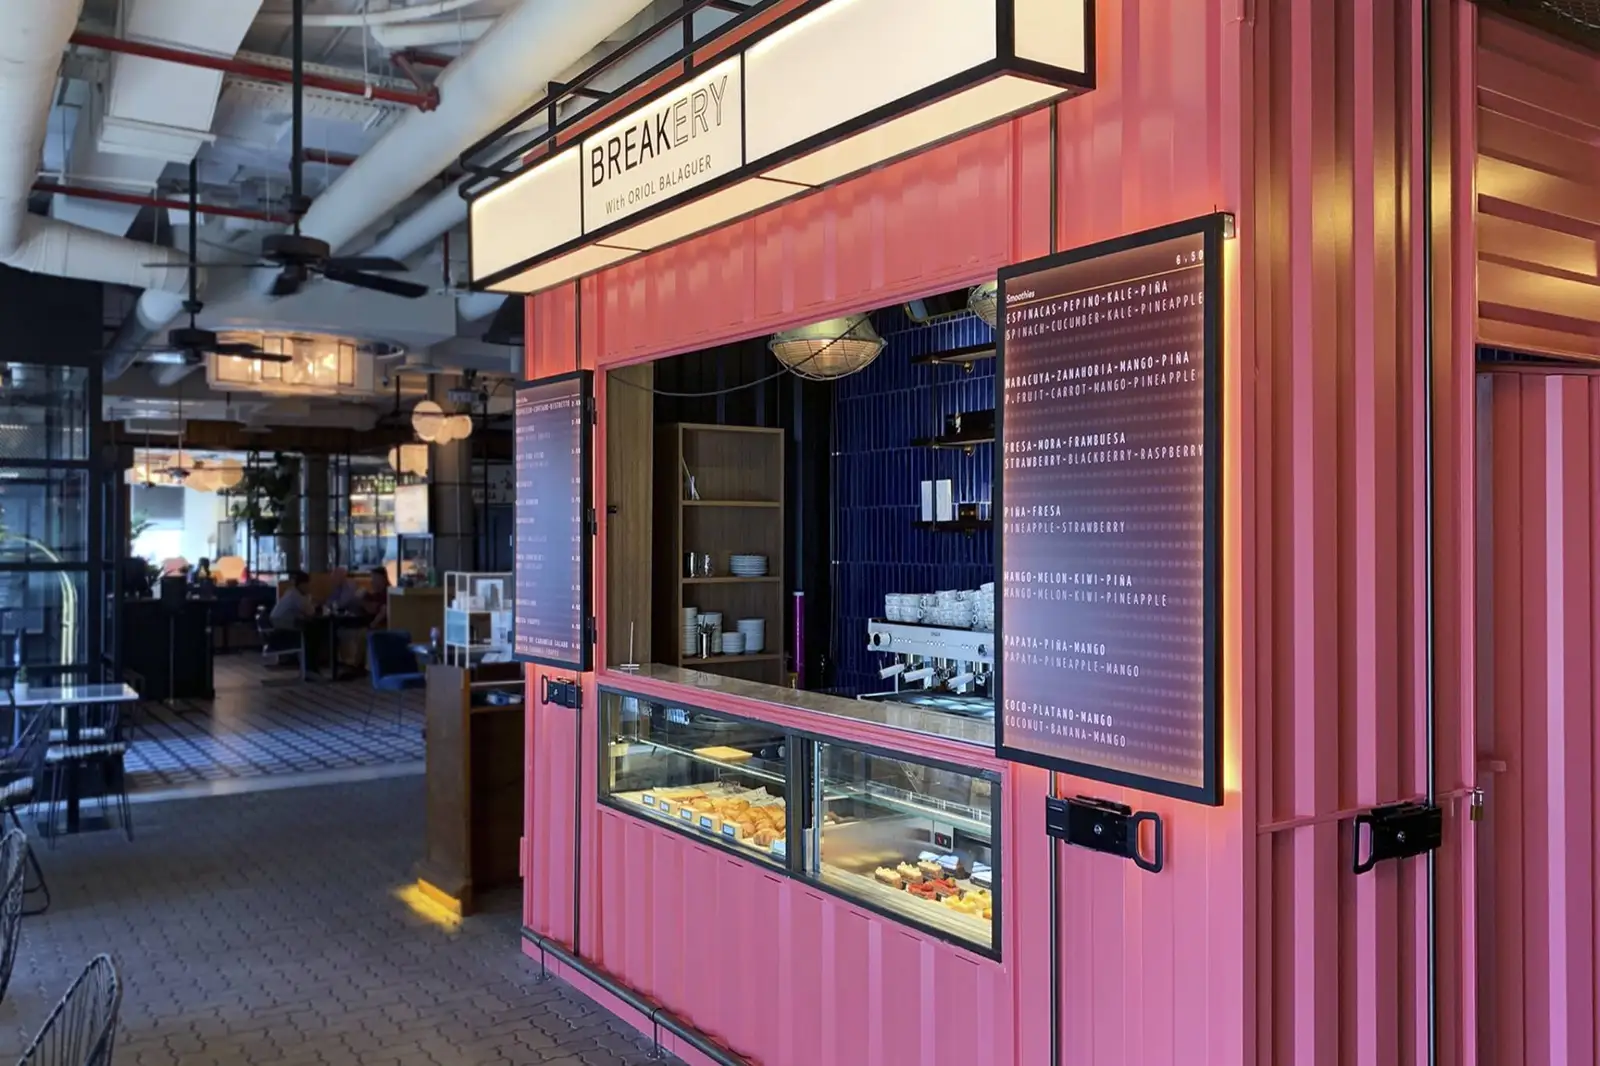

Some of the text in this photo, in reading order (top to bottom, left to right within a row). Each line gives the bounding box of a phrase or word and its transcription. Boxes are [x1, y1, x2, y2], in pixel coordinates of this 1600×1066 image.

[592, 75, 728, 188] BREAKERY
[605, 154, 712, 215] With ORIOL BALAGUER
[1006, 290, 1035, 304] Smoothies
[1004, 521, 1125, 534] PINEAPPLE-STRAWBERRY
